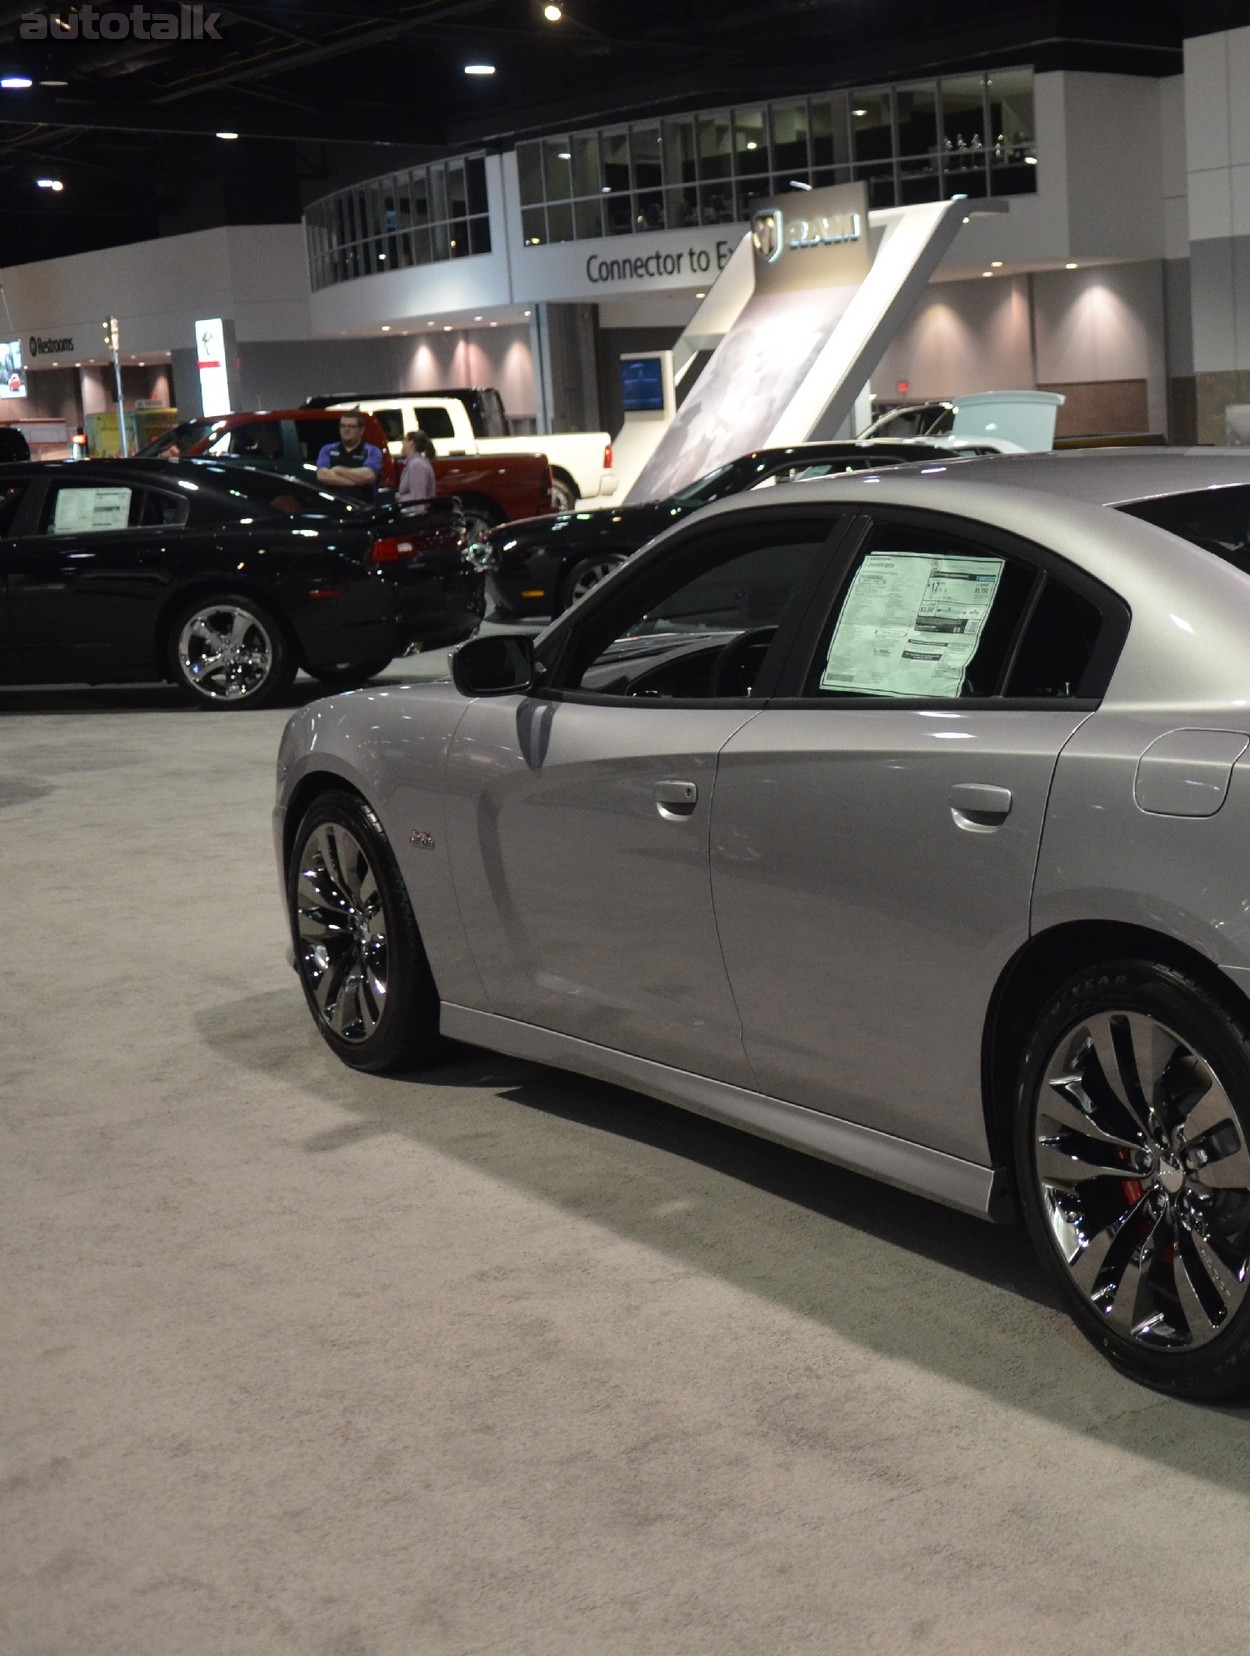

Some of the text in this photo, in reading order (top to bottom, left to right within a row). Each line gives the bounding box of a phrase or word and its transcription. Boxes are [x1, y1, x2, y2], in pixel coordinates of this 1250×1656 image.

[789, 214, 860, 249] RAM
[586, 241, 734, 282] Connector to E
[37, 337, 74, 354] Restrooms
